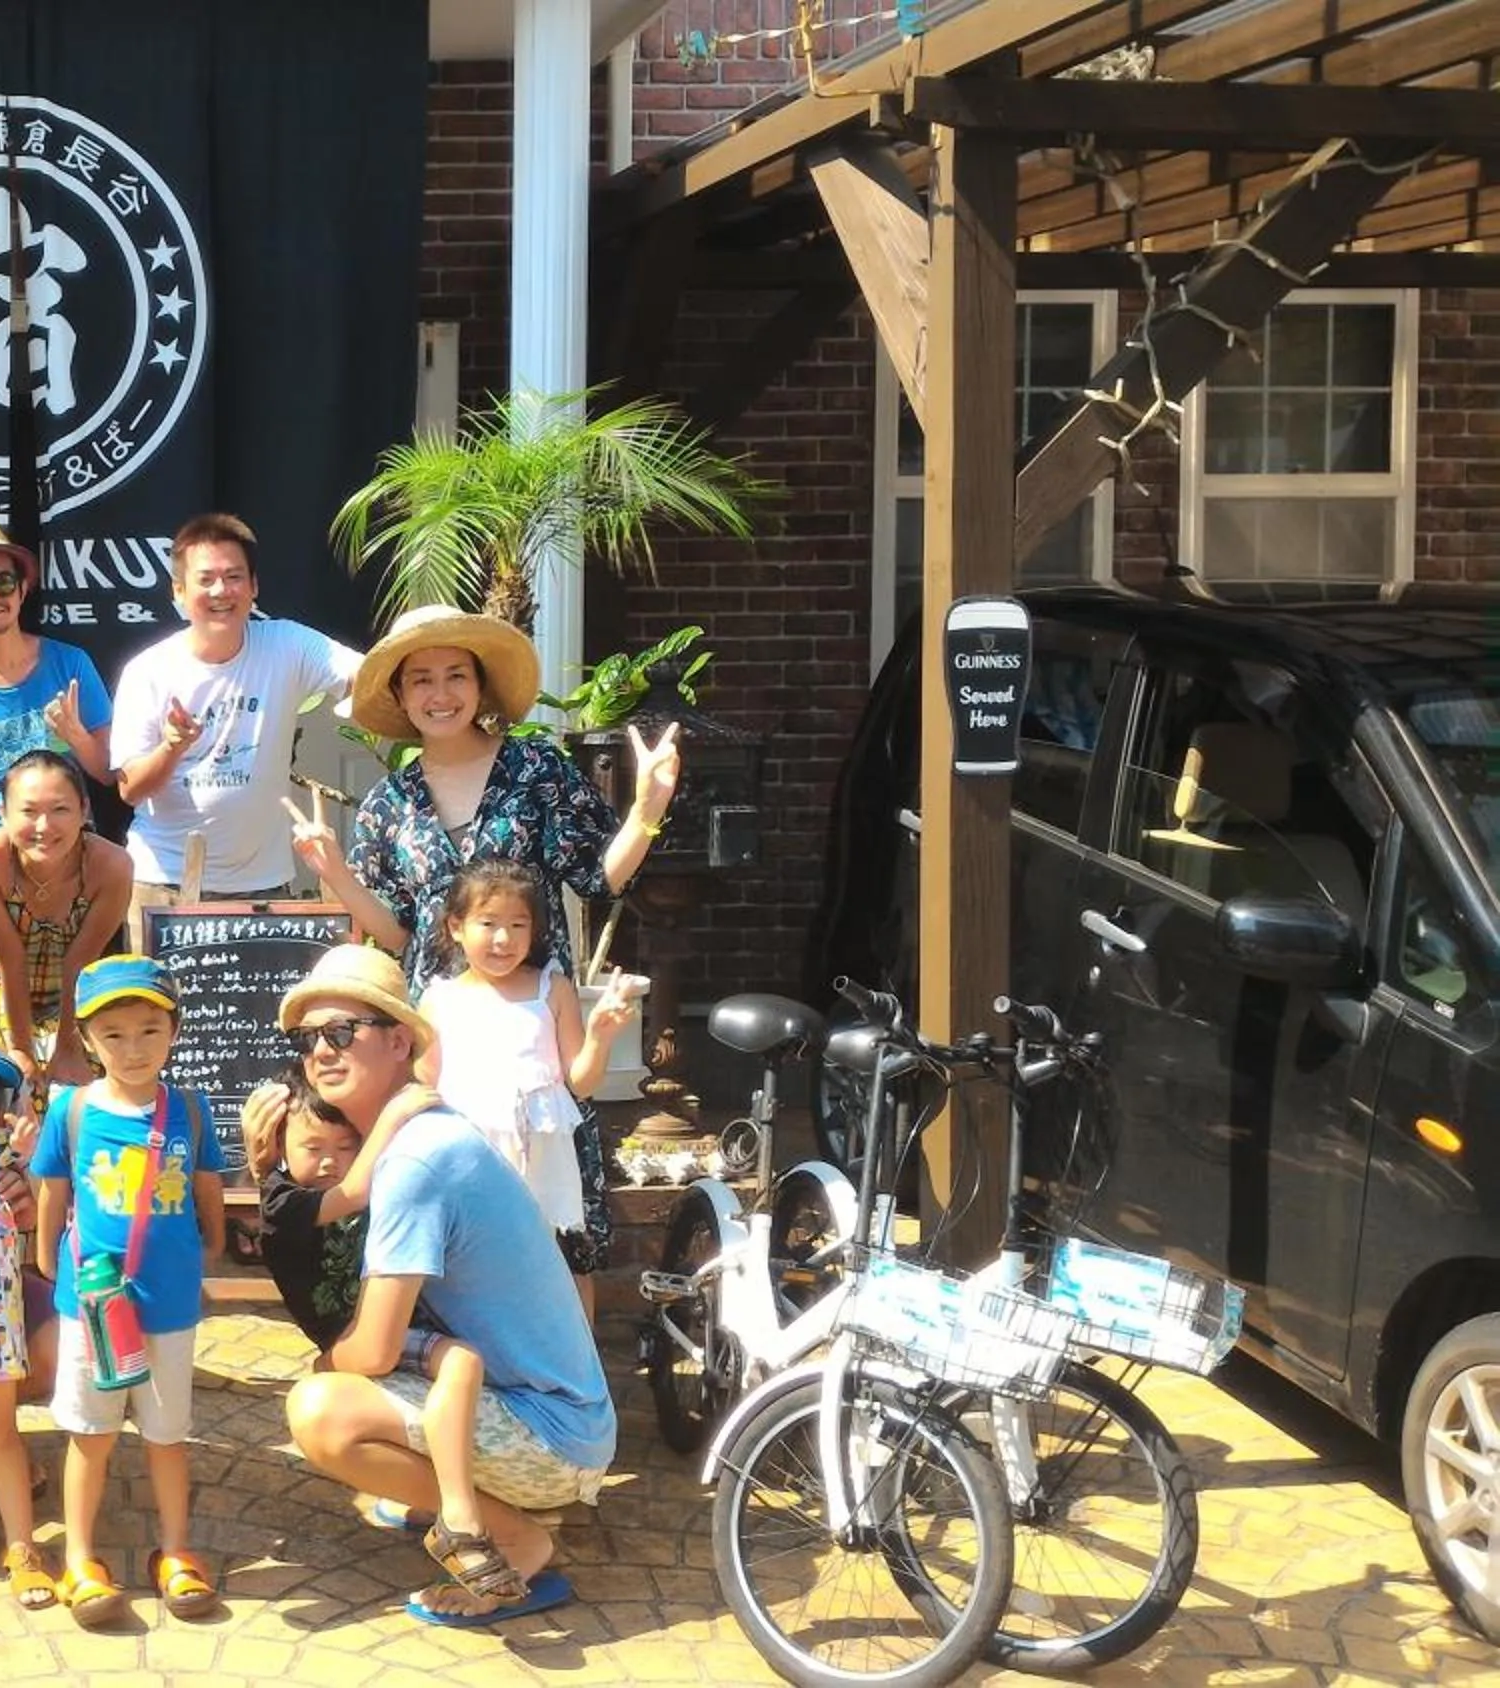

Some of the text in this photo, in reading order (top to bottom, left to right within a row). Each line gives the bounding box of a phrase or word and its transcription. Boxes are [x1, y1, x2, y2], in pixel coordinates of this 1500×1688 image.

[117, 601, 159, 623] &
[954, 652, 1021, 670] GUINNESS
[959, 685, 1016, 705] Served
[969, 709, 1009, 729] Here
[180, 1001, 223, 1019] lcohol
